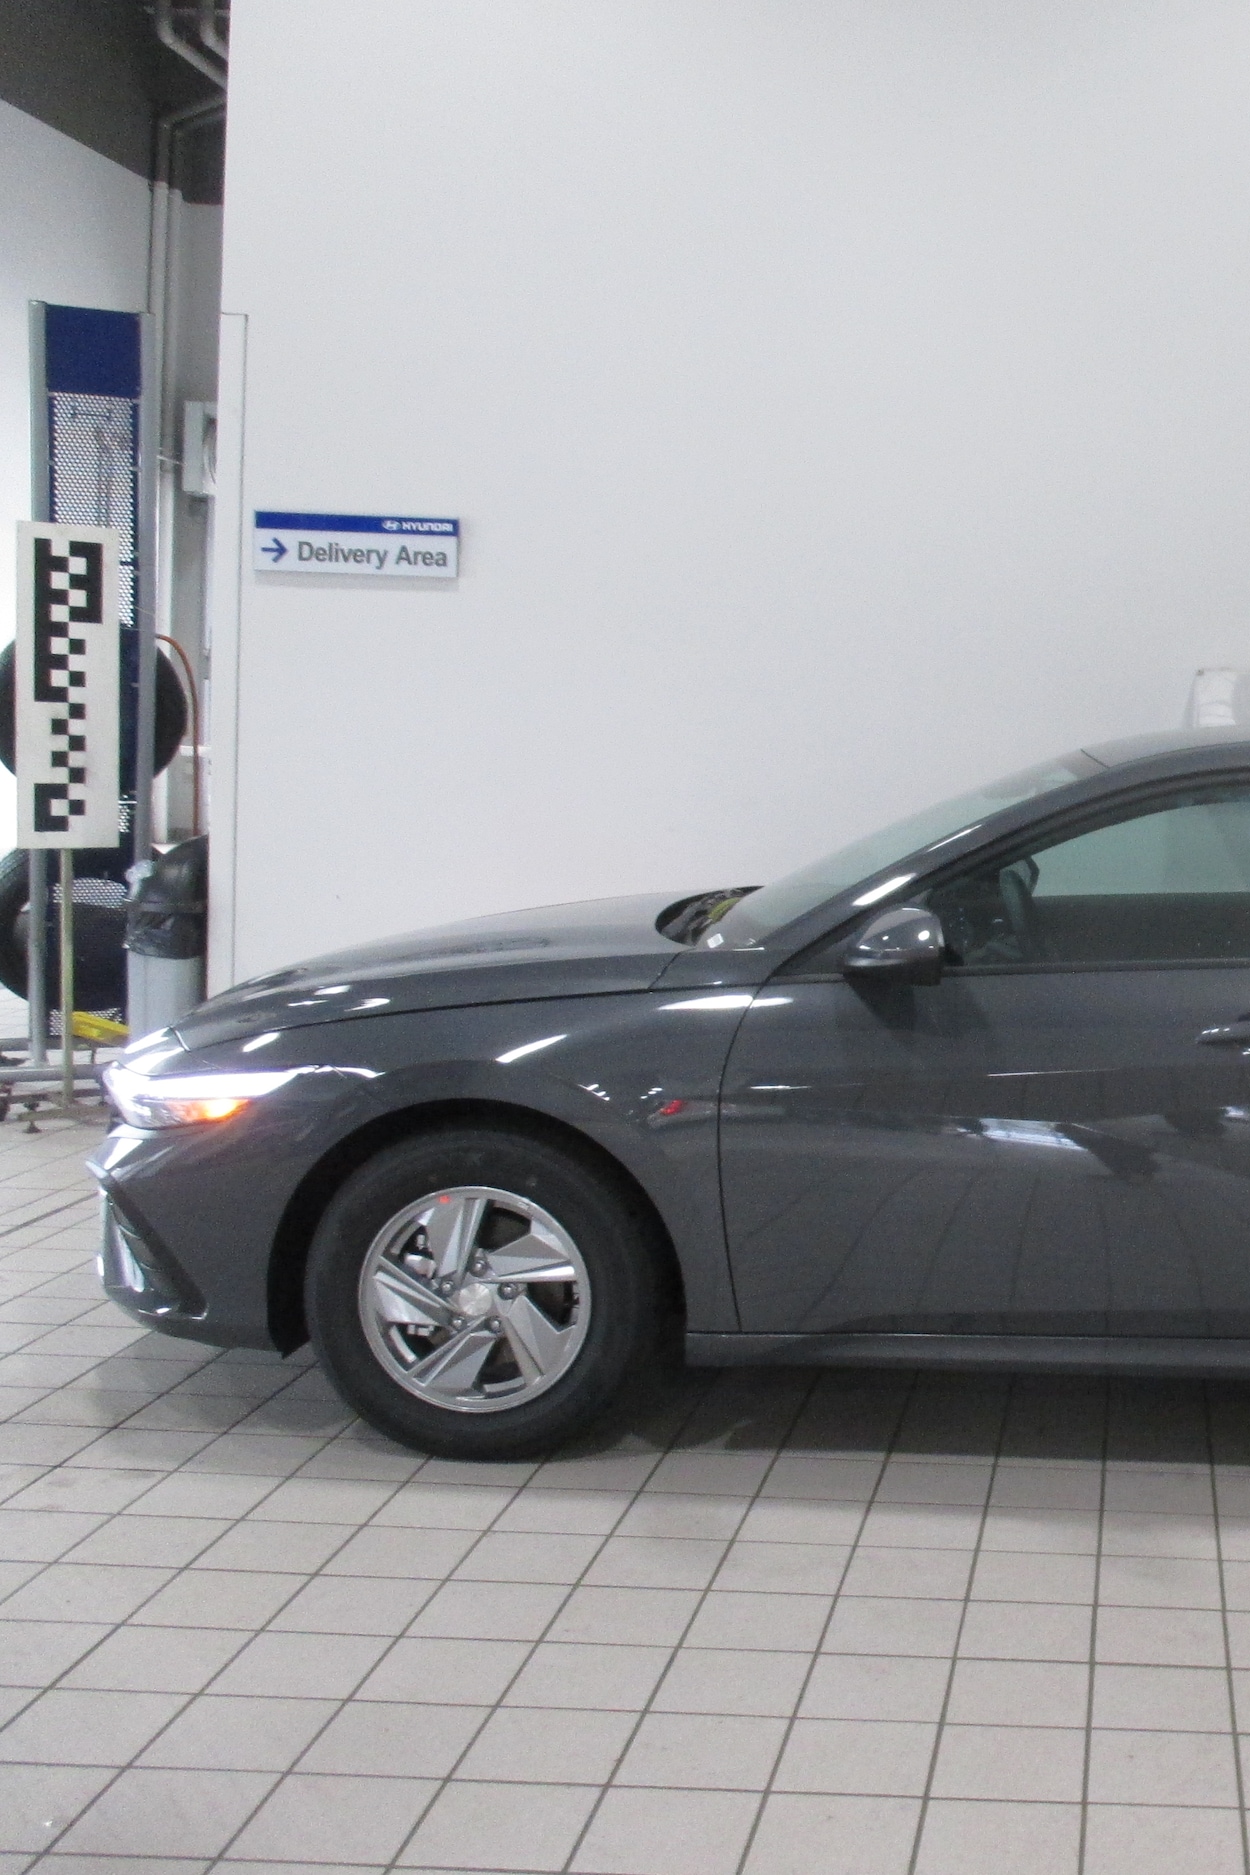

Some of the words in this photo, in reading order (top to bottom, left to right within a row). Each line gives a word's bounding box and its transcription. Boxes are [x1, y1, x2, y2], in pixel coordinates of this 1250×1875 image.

[402, 521, 453, 532] HYUNDAI
[298, 541, 387, 569] Delivery
[396, 545, 447, 567] Area
